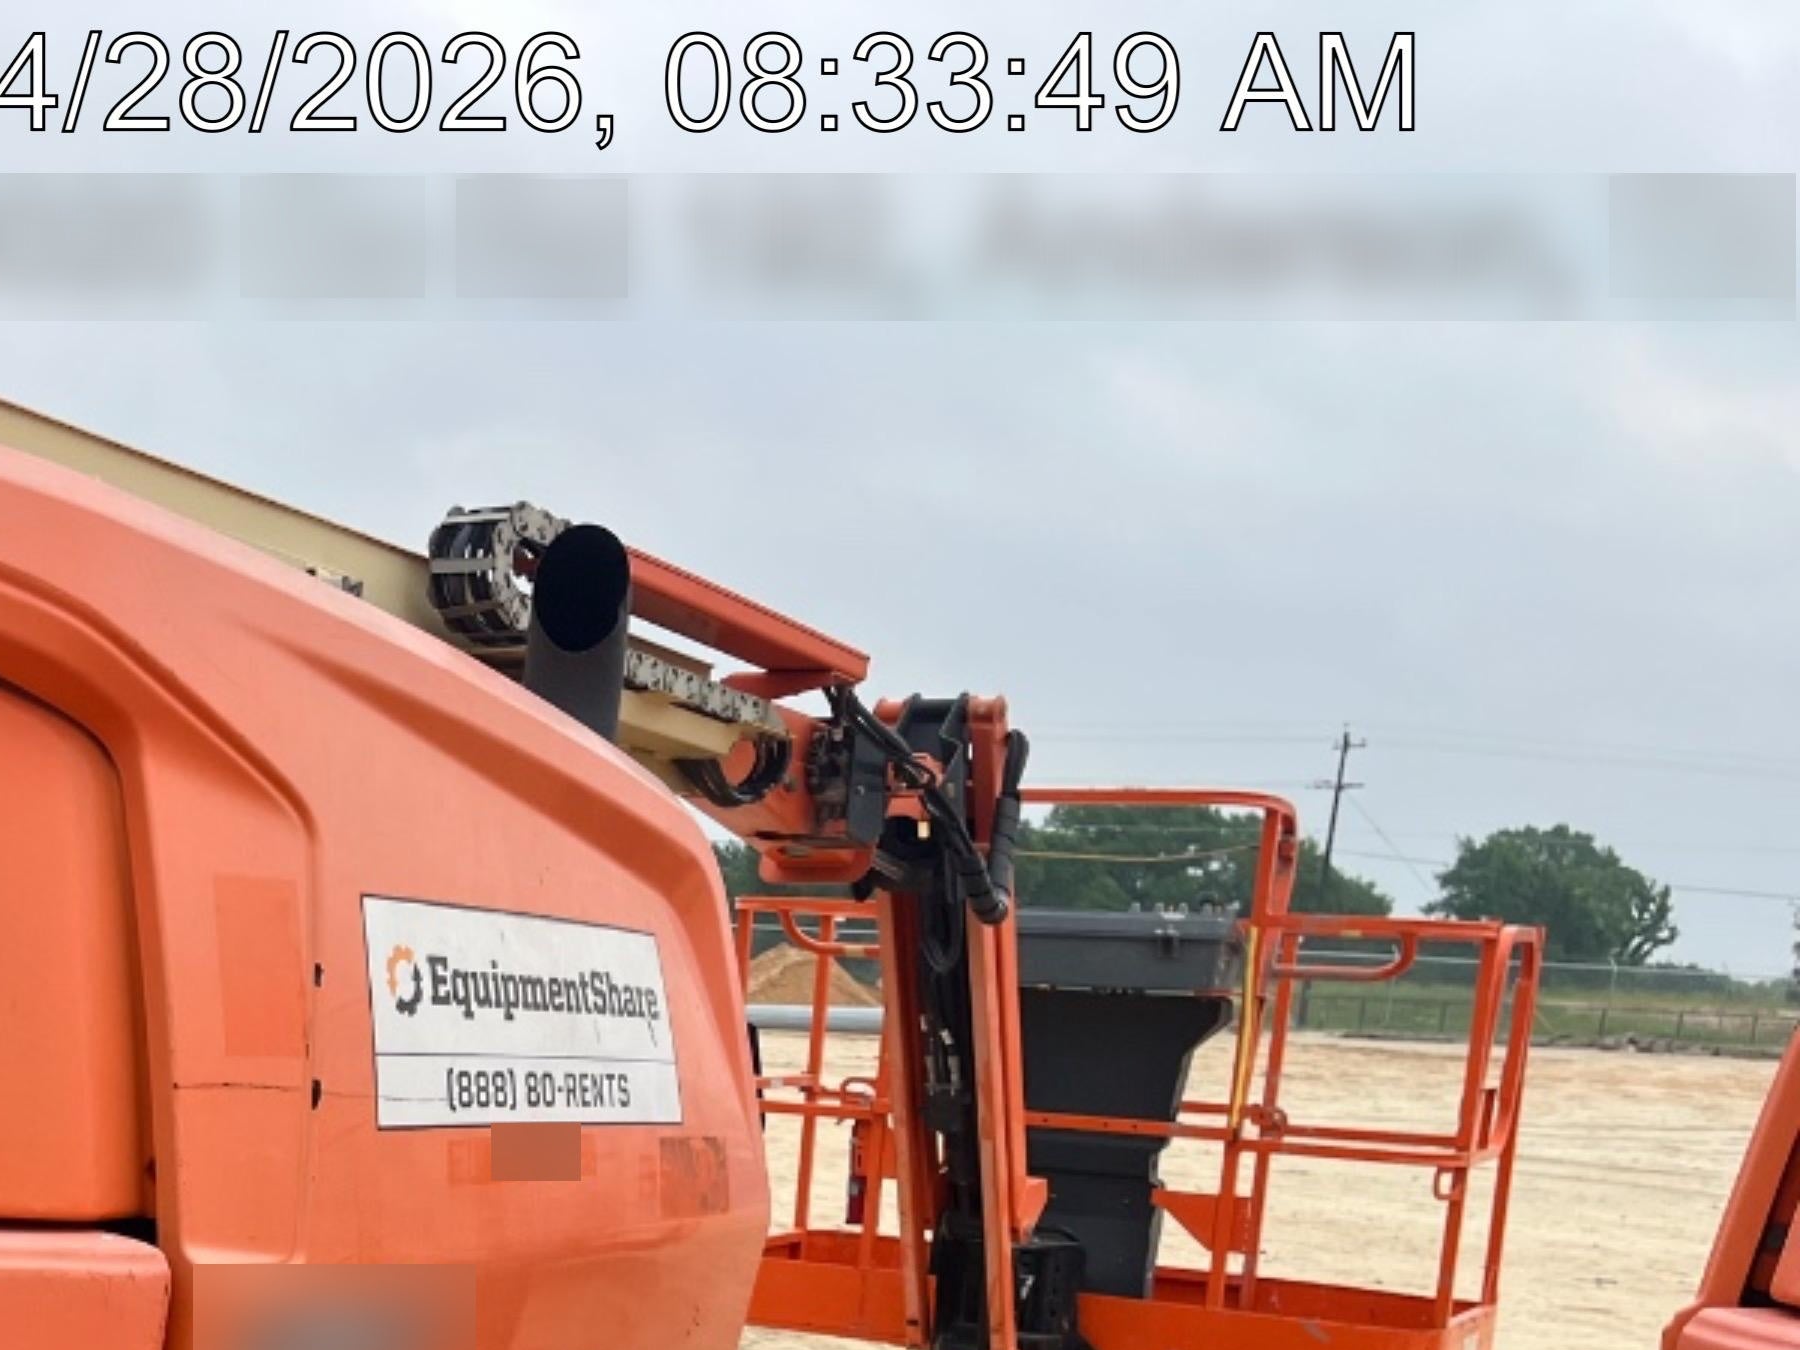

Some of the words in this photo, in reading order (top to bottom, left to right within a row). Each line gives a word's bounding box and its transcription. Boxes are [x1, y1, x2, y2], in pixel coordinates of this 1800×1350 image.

[425, 953, 661, 1022] EquipmentShare
[446, 1067, 518, 1112] (888)
[525, 1071, 632, 1109] 80-RENTS
